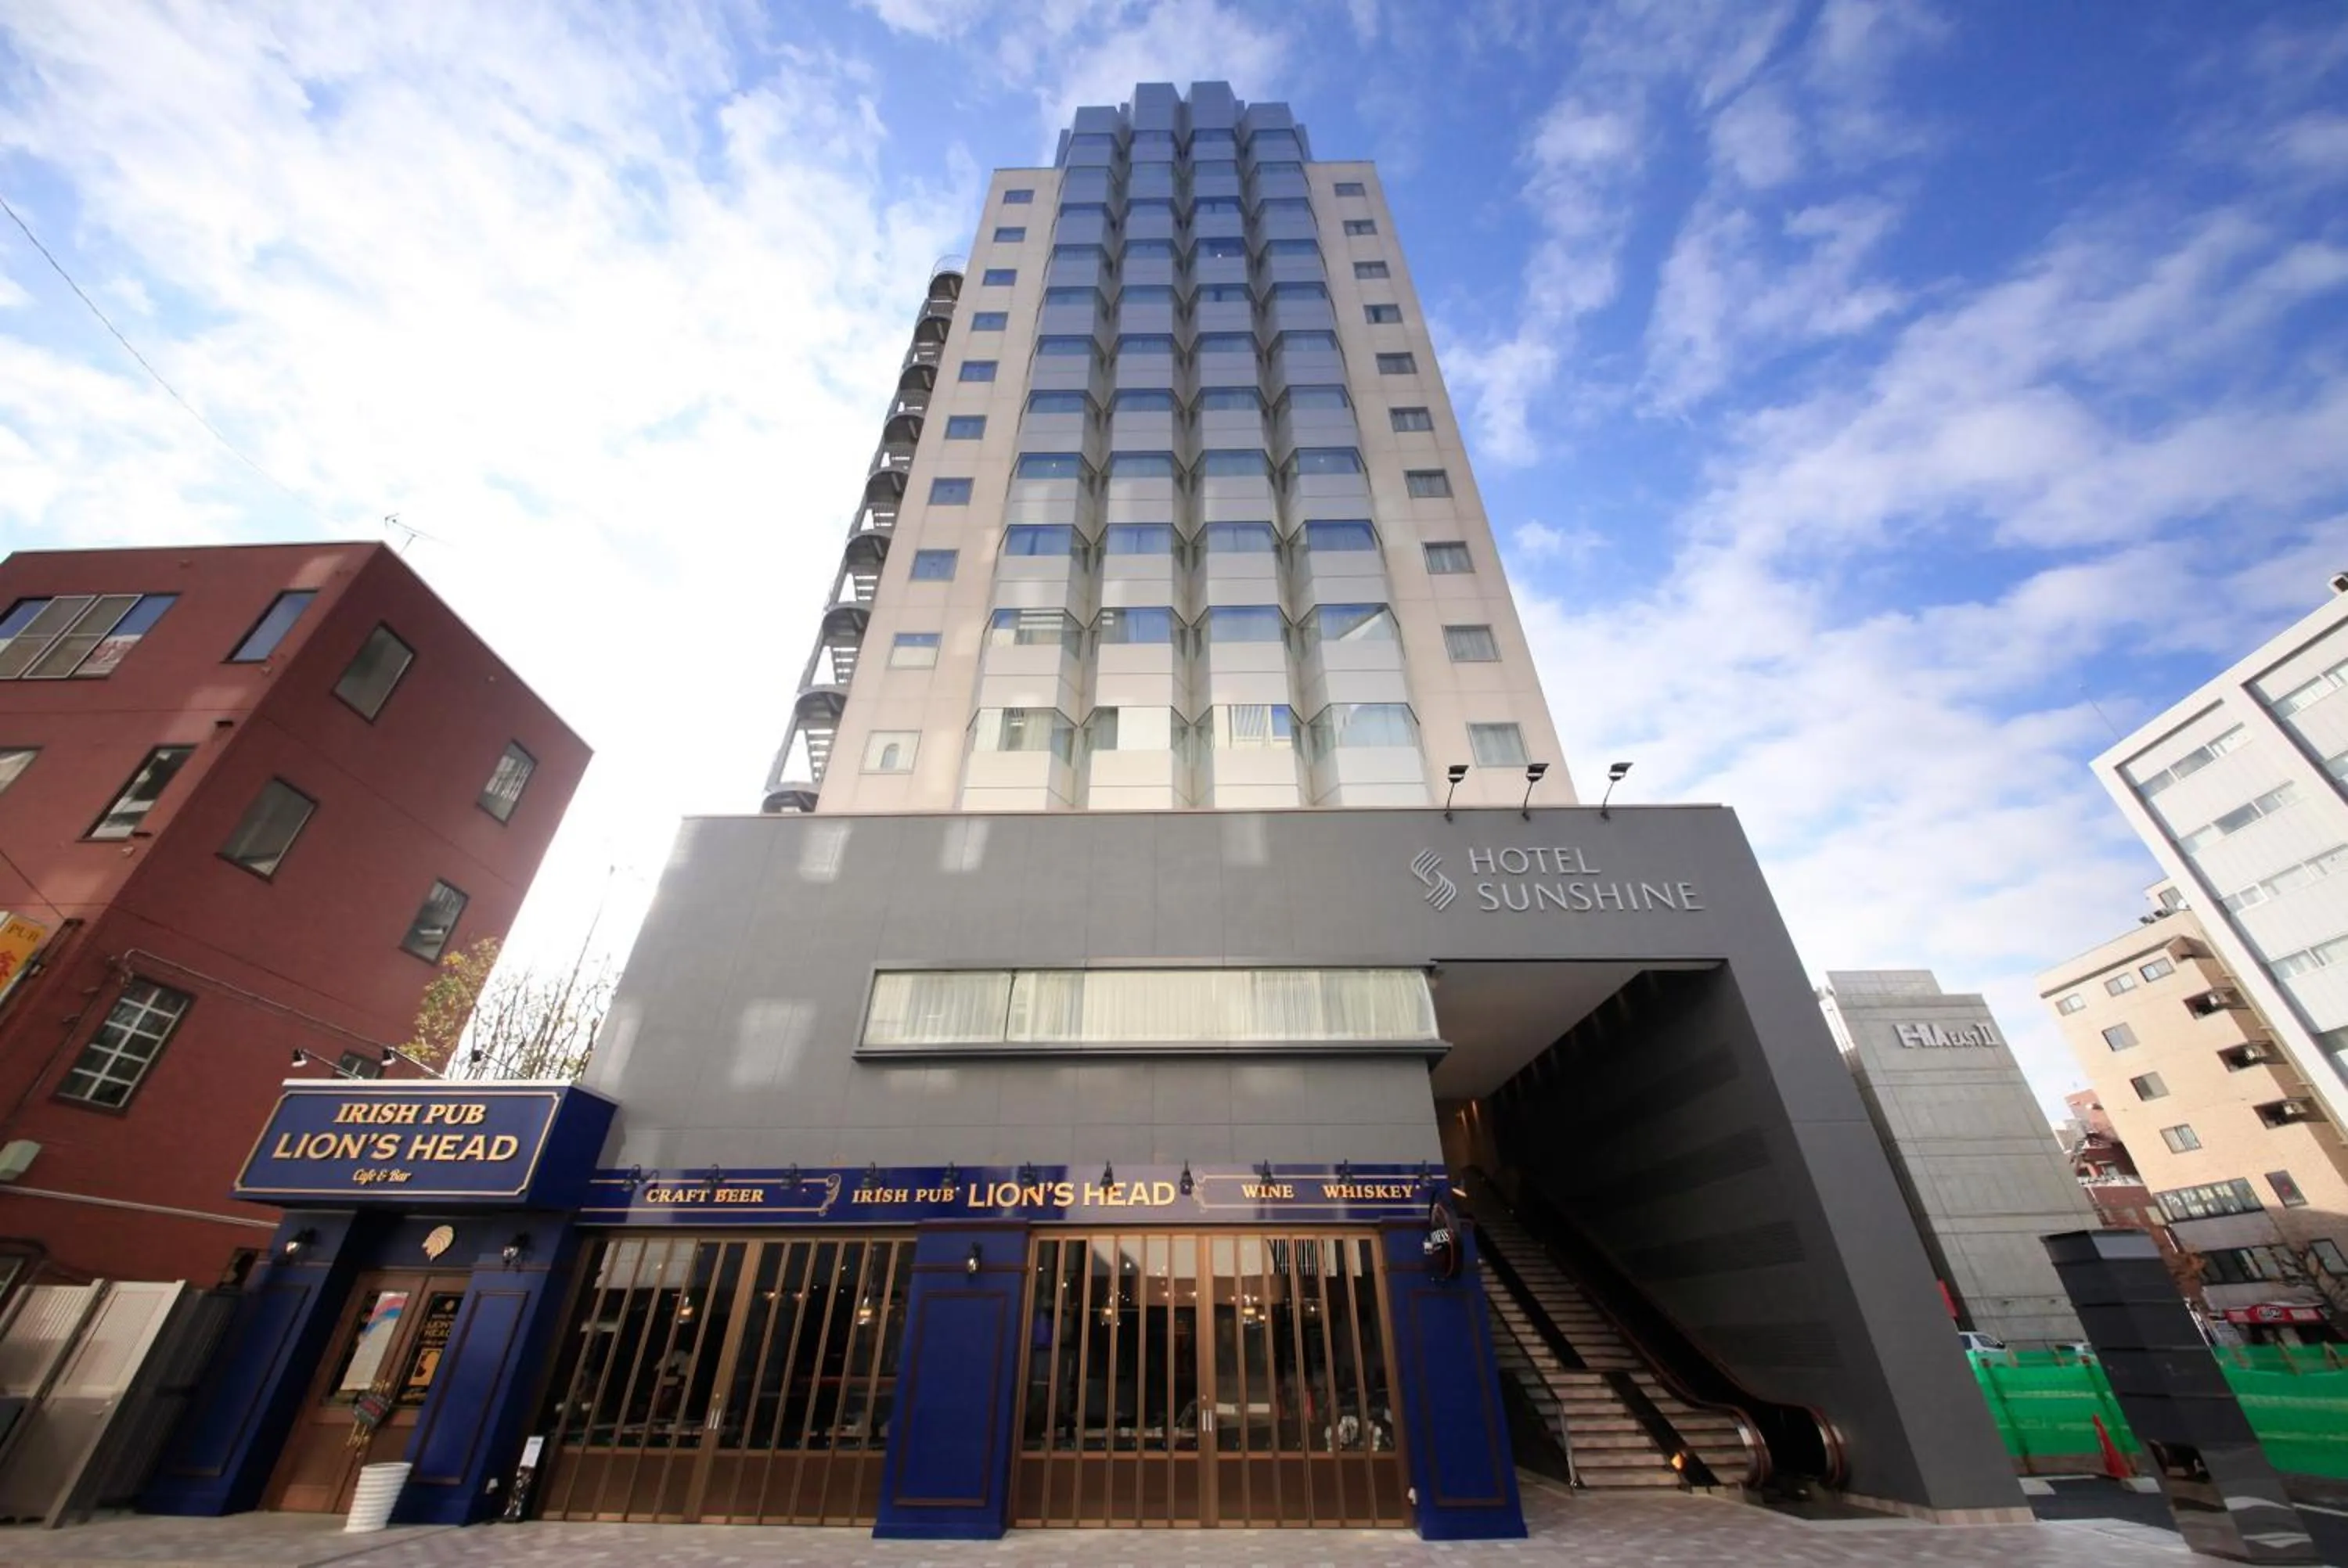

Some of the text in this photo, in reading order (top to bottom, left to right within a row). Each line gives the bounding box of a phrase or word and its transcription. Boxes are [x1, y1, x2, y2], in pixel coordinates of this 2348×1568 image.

[1468, 847, 1601, 875] HOTEL
[1477, 881, 1705, 911] SUNSHINE
[333, 1102, 486, 1125] IRISH PUB
[272, 1132, 518, 1161] LION'S HEAD
[351, 1167, 412, 1185] Cafe & Bar
[645, 1187, 764, 1203] CRAFT BEER
[852, 1187, 955, 1203] IRISH PUB
[967, 1181, 1176, 1208] LION'S HEAD
[1241, 1183, 1295, 1199] WINE
[1323, 1183, 1413, 1199] WHISKEY
